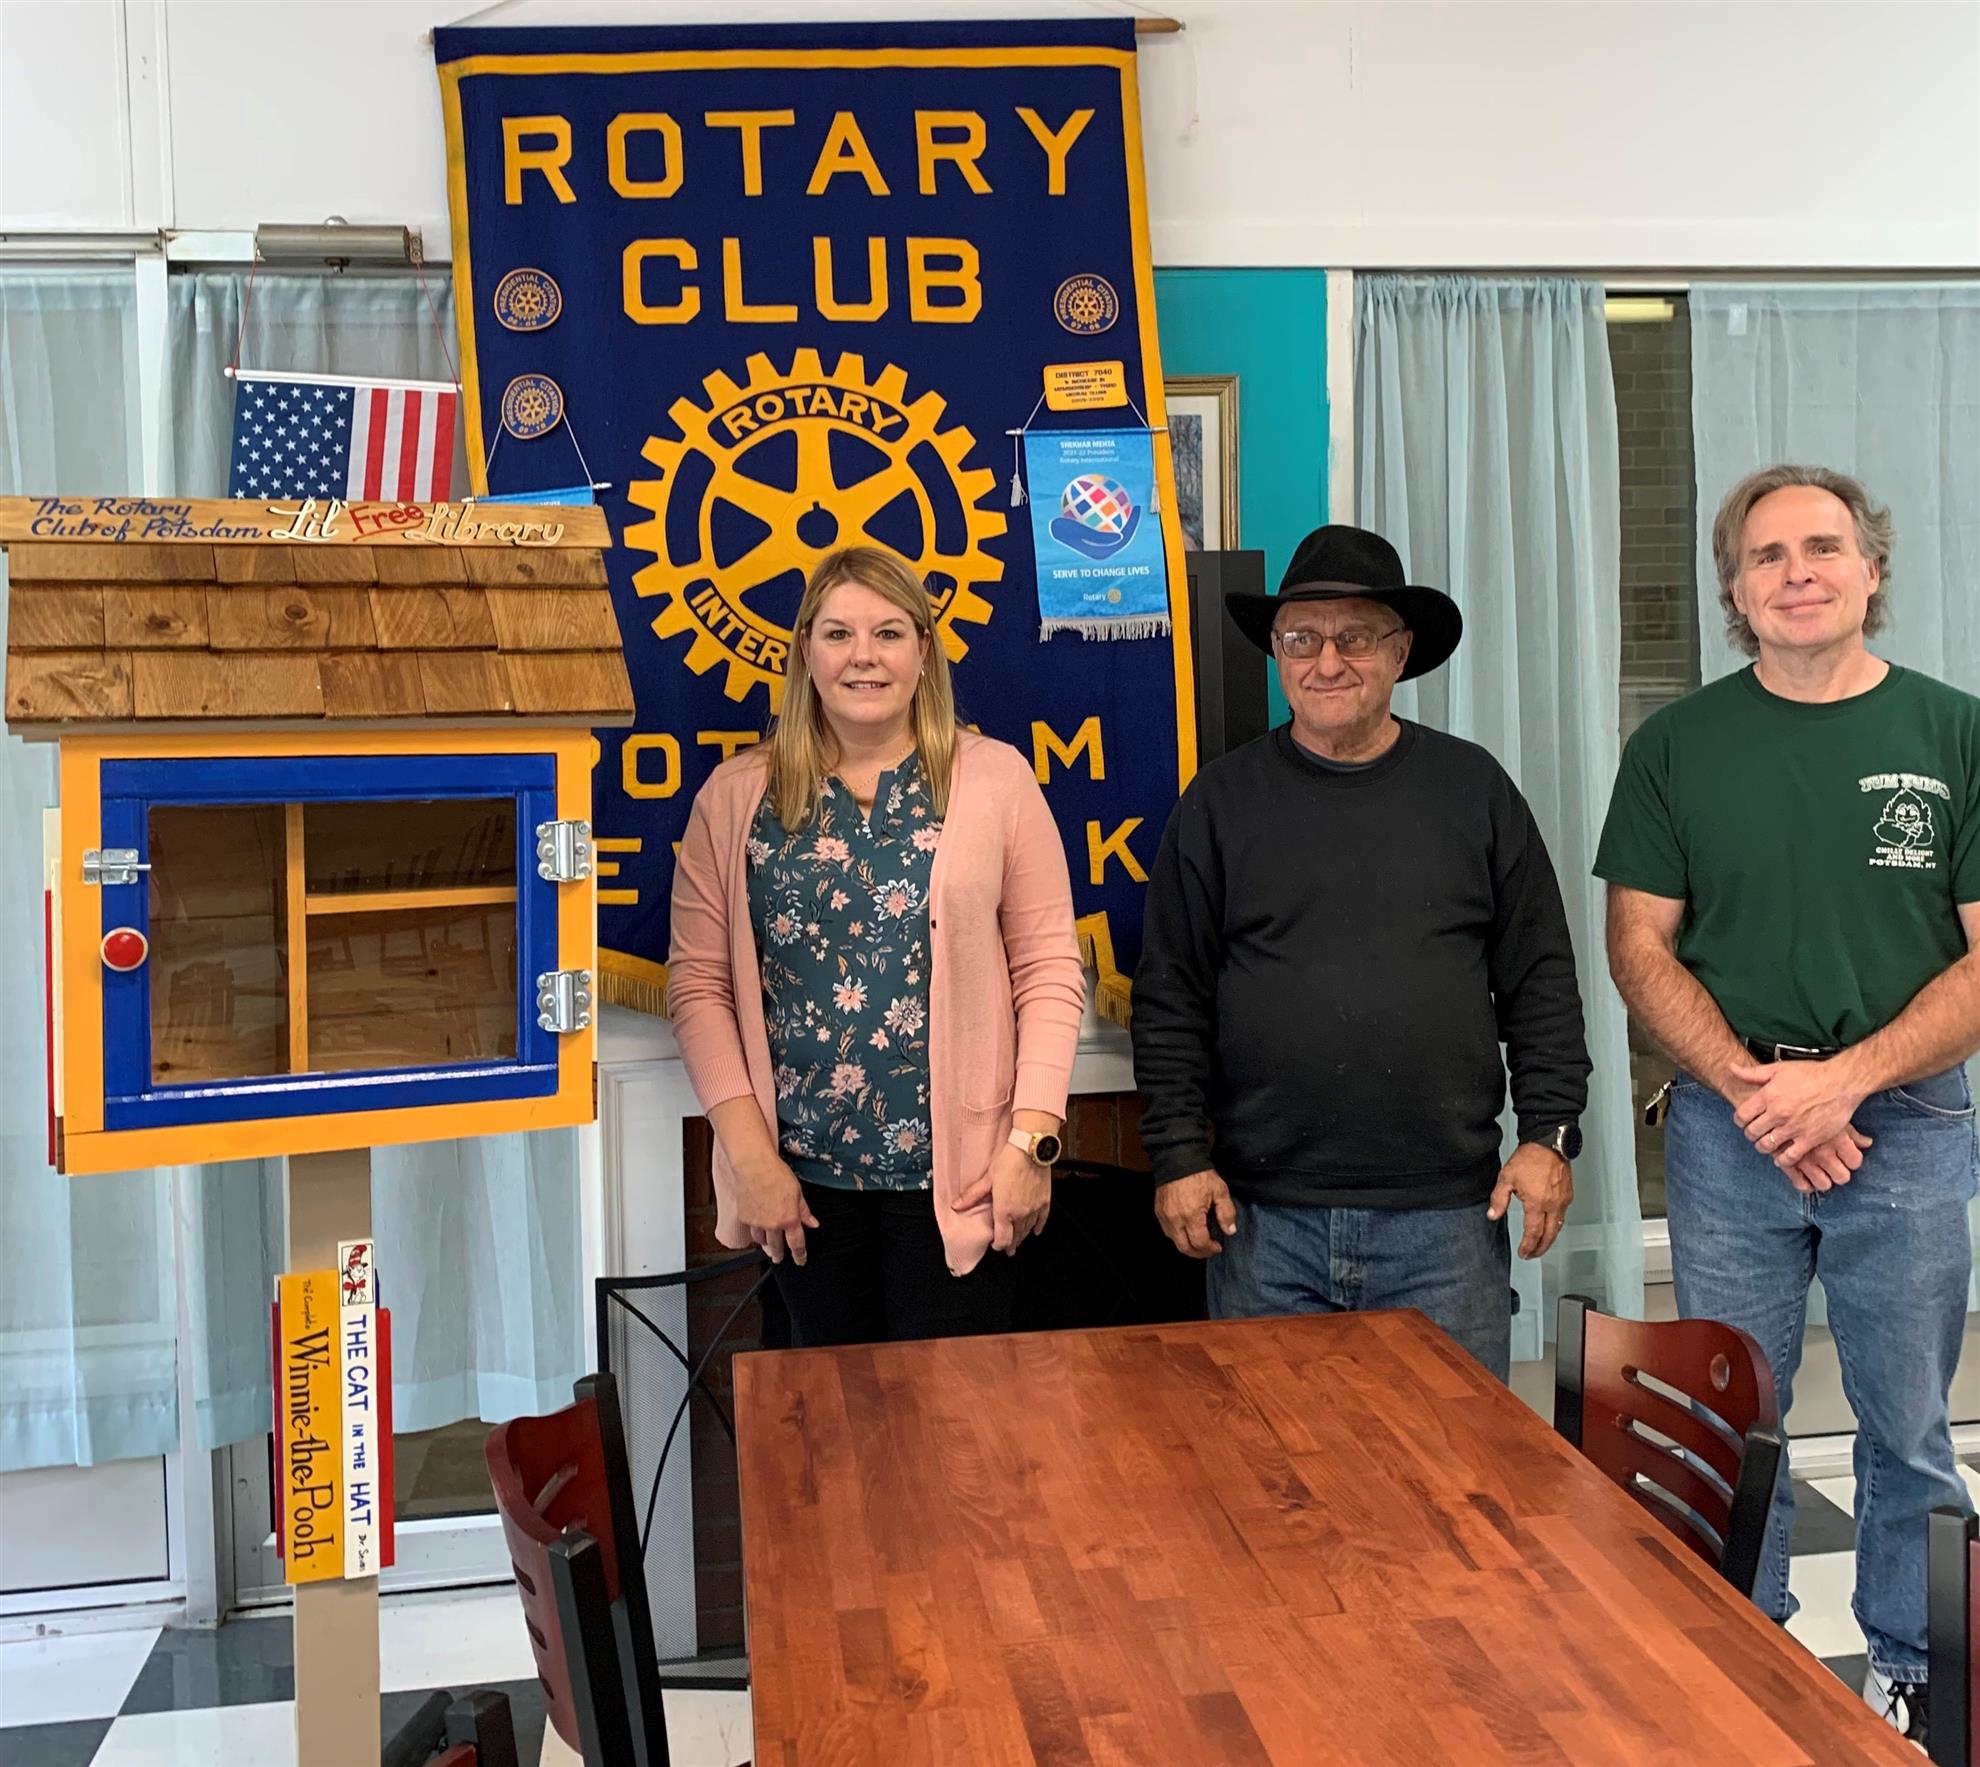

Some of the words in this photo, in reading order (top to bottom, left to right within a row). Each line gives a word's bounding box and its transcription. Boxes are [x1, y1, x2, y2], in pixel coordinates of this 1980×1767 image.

[501, 107, 1095, 205] ROTARY
[500, 274, 540, 313] PRESIDENTIAL
[543, 281, 557, 318] CITATION
[622, 236, 983, 325] CLUB
[1059, 279, 1094, 320] PRESIDENTIAL
[1097, 284, 1113, 319] CITATION
[1055, 370, 1089, 379] DISTRICT
[506, 379, 538, 427] PRESIDENTIAL
[540, 381, 558, 416] CITATION
[720, 386, 902, 441] ROTARY
[30, 498, 84, 516] The
[93, 497, 193, 518] Rotary
[403, 503, 565, 545] Library
[31, 518, 99, 537] Club
[101, 518, 137, 543] of
[141, 517, 263, 539] Potsdam
[1052, 569, 1078, 579] SERVE
[1080, 568, 1091, 578] TO
[1092, 567, 1126, 577] CHANGE
[1127, 566, 1150, 576] LIVES
[1083, 593, 1107, 601] Rotary
[1869, 858, 1924, 869] POTSDAM,
[347, 1314, 368, 1360] THE
[347, 1366, 369, 1411] CAT
[288, 1326, 335, 1563] Winnie-the-Pooh
[352, 1424, 364, 1437] IN
[353, 1442, 366, 1470] THE
[350, 1482, 372, 1526] HAT
